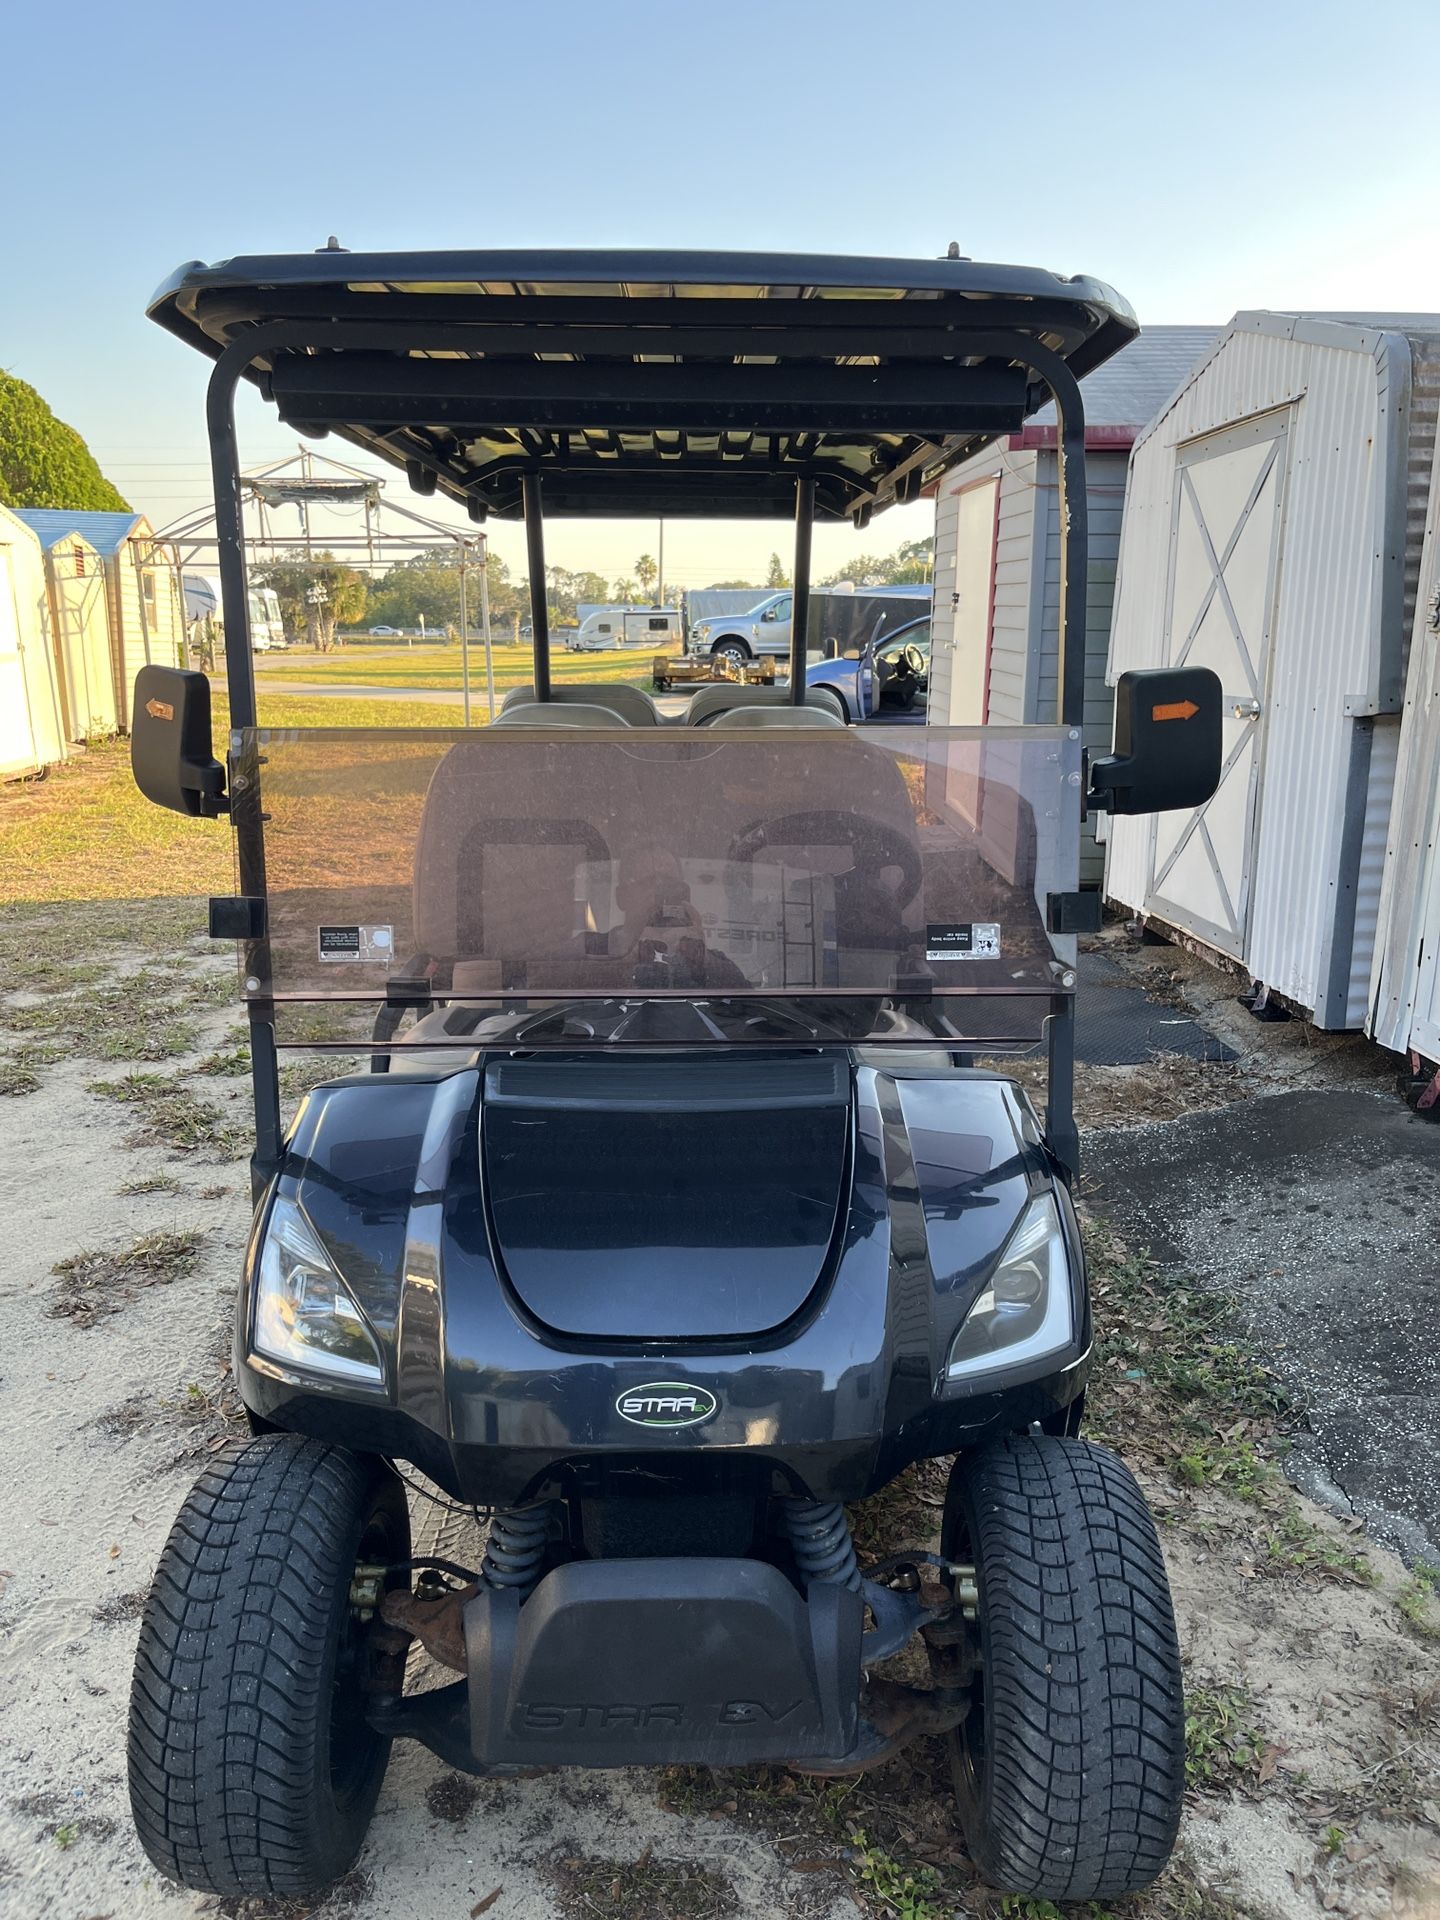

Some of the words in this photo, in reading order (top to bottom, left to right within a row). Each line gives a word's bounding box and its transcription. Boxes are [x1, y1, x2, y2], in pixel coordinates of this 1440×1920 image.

[623, 1397, 697, 1413] STAR
[694, 1404, 713, 1412] EV
[525, 1702, 685, 1729] STAR
[718, 1699, 802, 1727] EV
